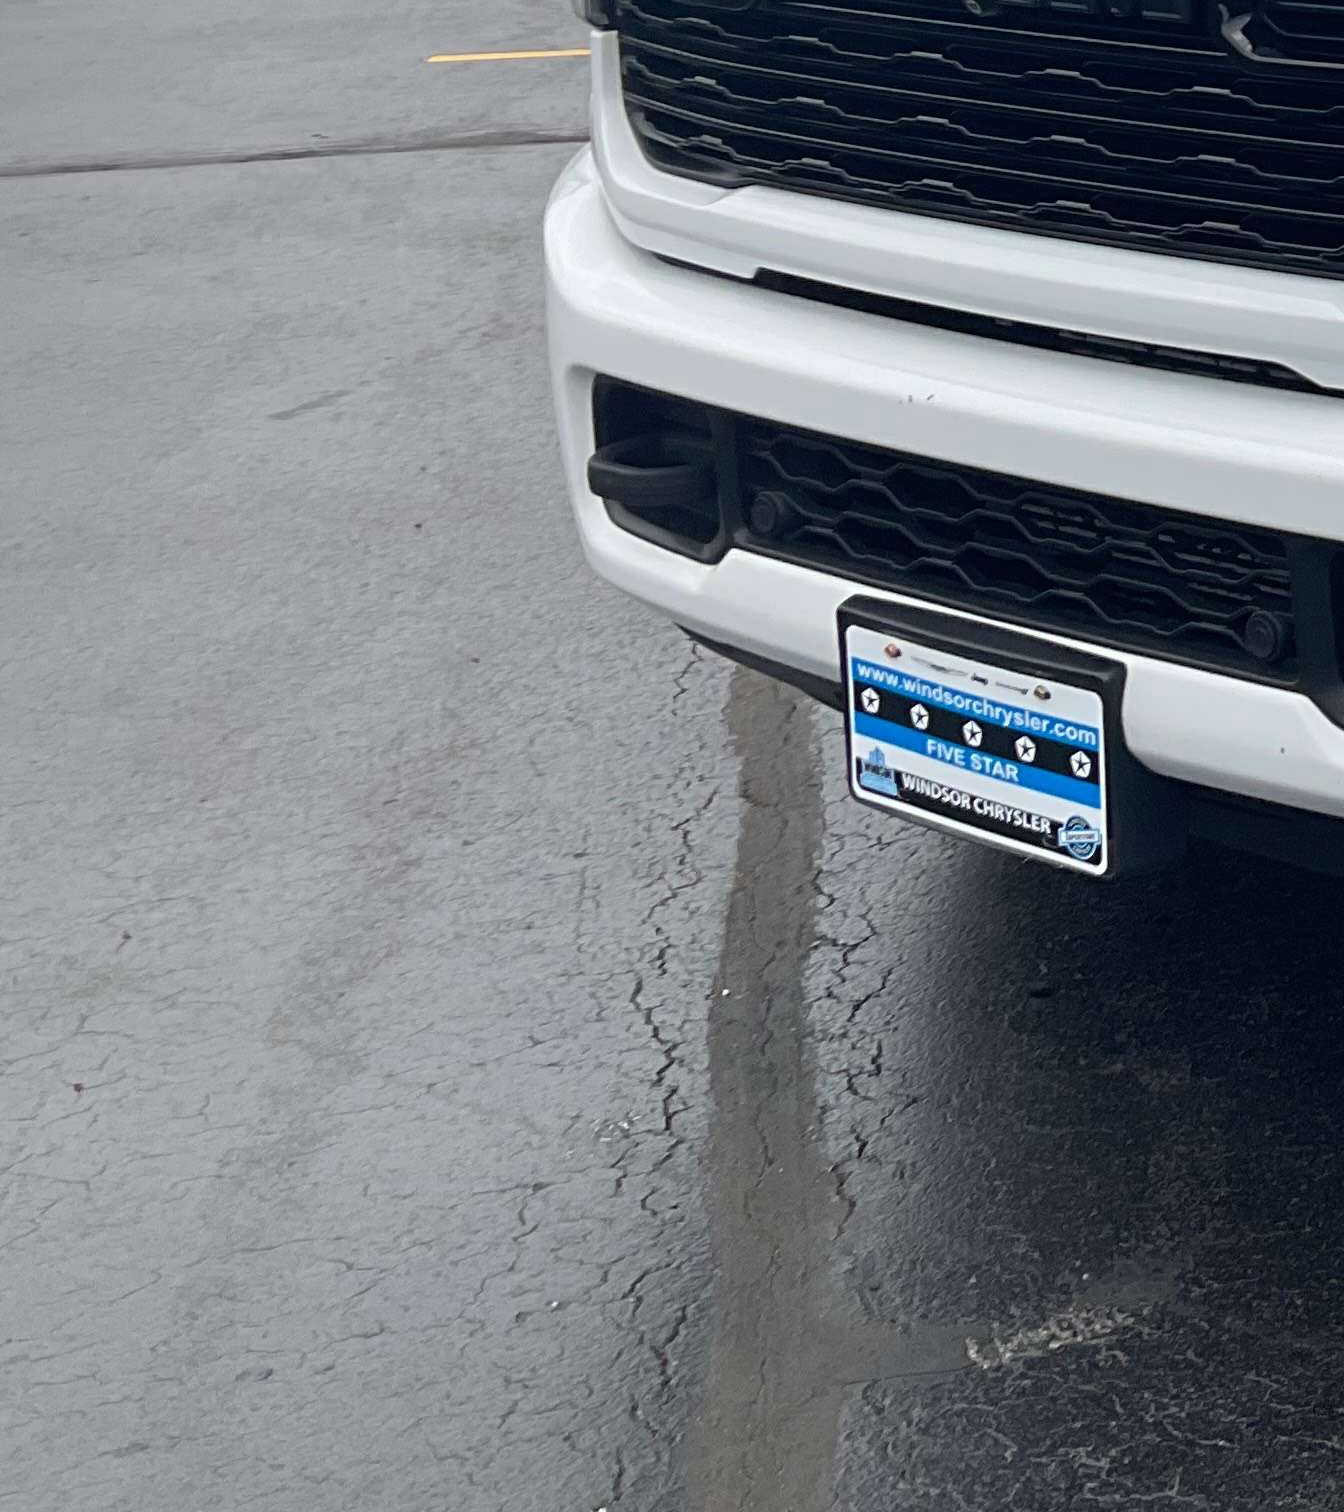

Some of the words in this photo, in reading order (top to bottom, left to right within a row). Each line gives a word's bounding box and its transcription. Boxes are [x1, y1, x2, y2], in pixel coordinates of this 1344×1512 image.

[856, 661, 1097, 747] www.windsorchrysler.com
[926, 738, 966, 766] FIVE
[969, 752, 1020, 783] STAR
[901, 772, 972, 811] WINDSOR
[973, 797, 1052, 835] CHRYSLER
